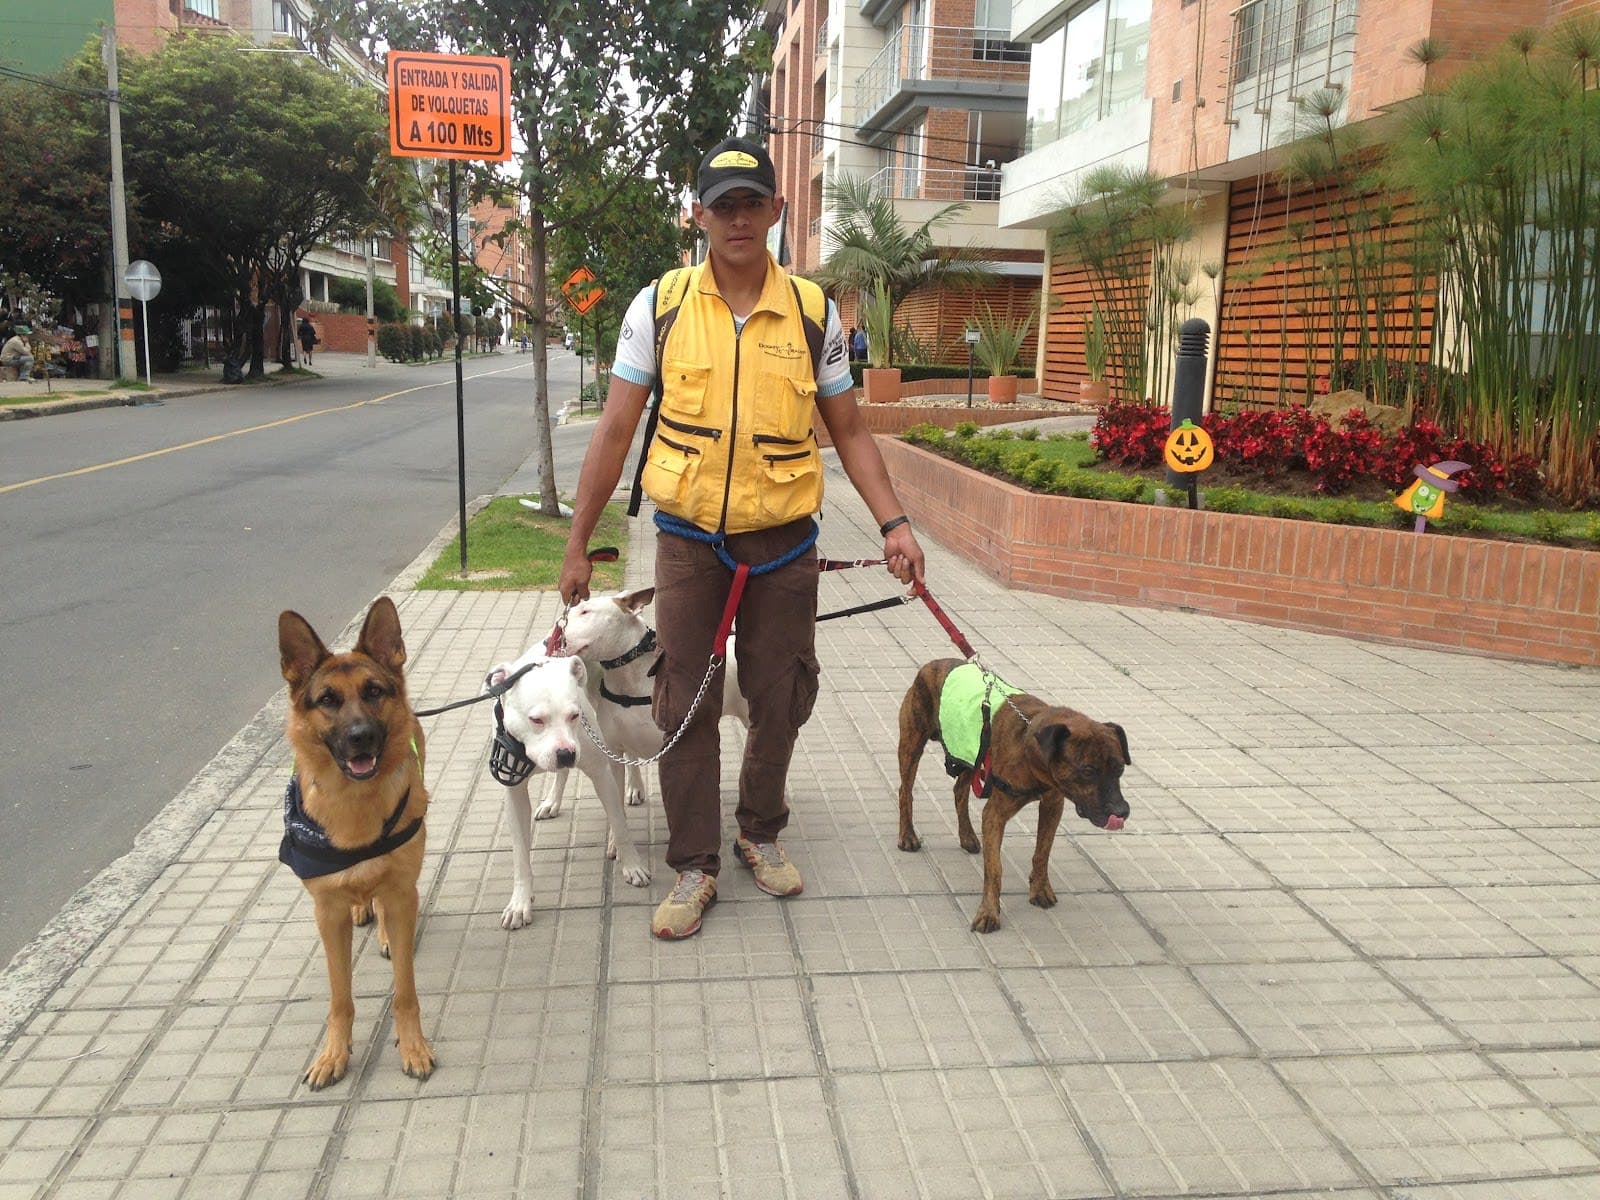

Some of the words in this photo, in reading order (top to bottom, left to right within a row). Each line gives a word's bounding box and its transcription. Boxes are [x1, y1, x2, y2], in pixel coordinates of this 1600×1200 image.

[400, 68, 449, 88] ENTRADA
[452, 71, 458, 89] Y
[461, 72, 498, 92] SALIDA
[411, 94, 425, 112] DE
[427, 95, 489, 116] VOLQUETAS
[410, 120, 422, 142] A
[427, 121, 457, 145] 100
[463, 123, 493, 147] Mts
